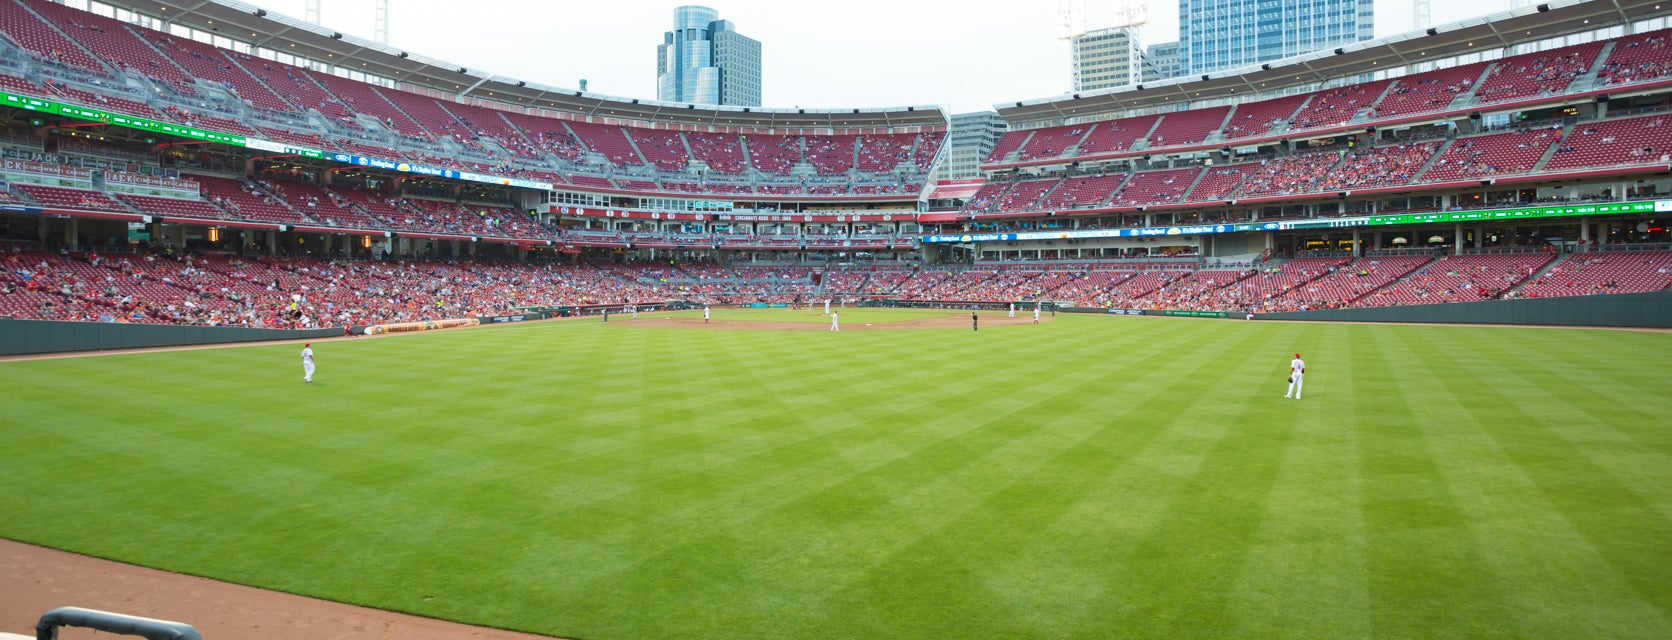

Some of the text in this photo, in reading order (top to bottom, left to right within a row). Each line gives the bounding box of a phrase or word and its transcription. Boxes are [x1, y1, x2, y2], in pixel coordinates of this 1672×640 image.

[25, 165, 64, 174] CINCINNATI
[65, 169, 90, 177] CASINO
[107, 172, 198, 189] JACK CINCINNATI CASINO
